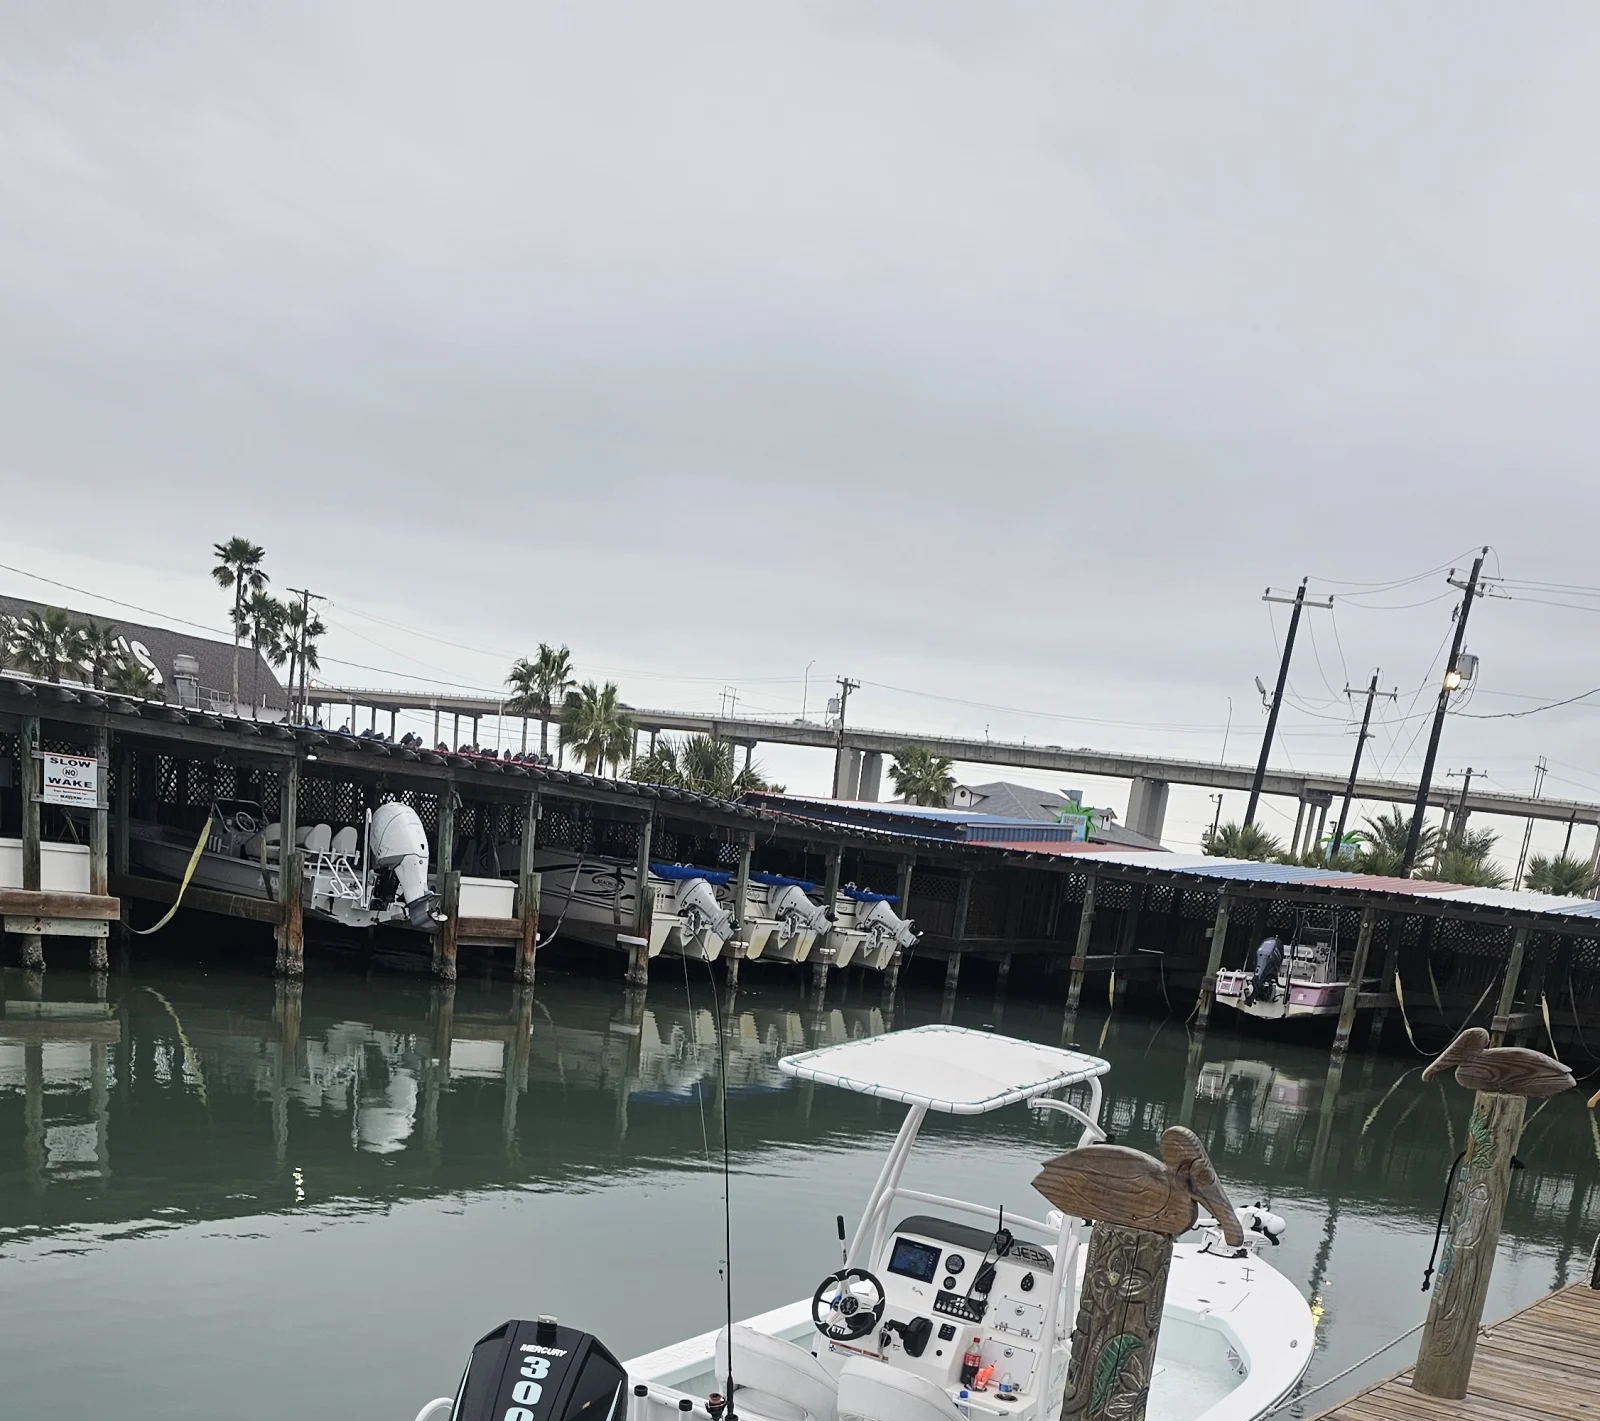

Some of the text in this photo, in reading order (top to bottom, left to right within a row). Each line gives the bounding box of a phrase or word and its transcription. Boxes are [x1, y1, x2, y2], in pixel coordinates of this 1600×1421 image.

[49, 757, 91, 768] SLOW
[64, 769, 76, 777] NO
[47, 776, 93, 789] WAKE
[519, 1343, 568, 1357] MERCURY
